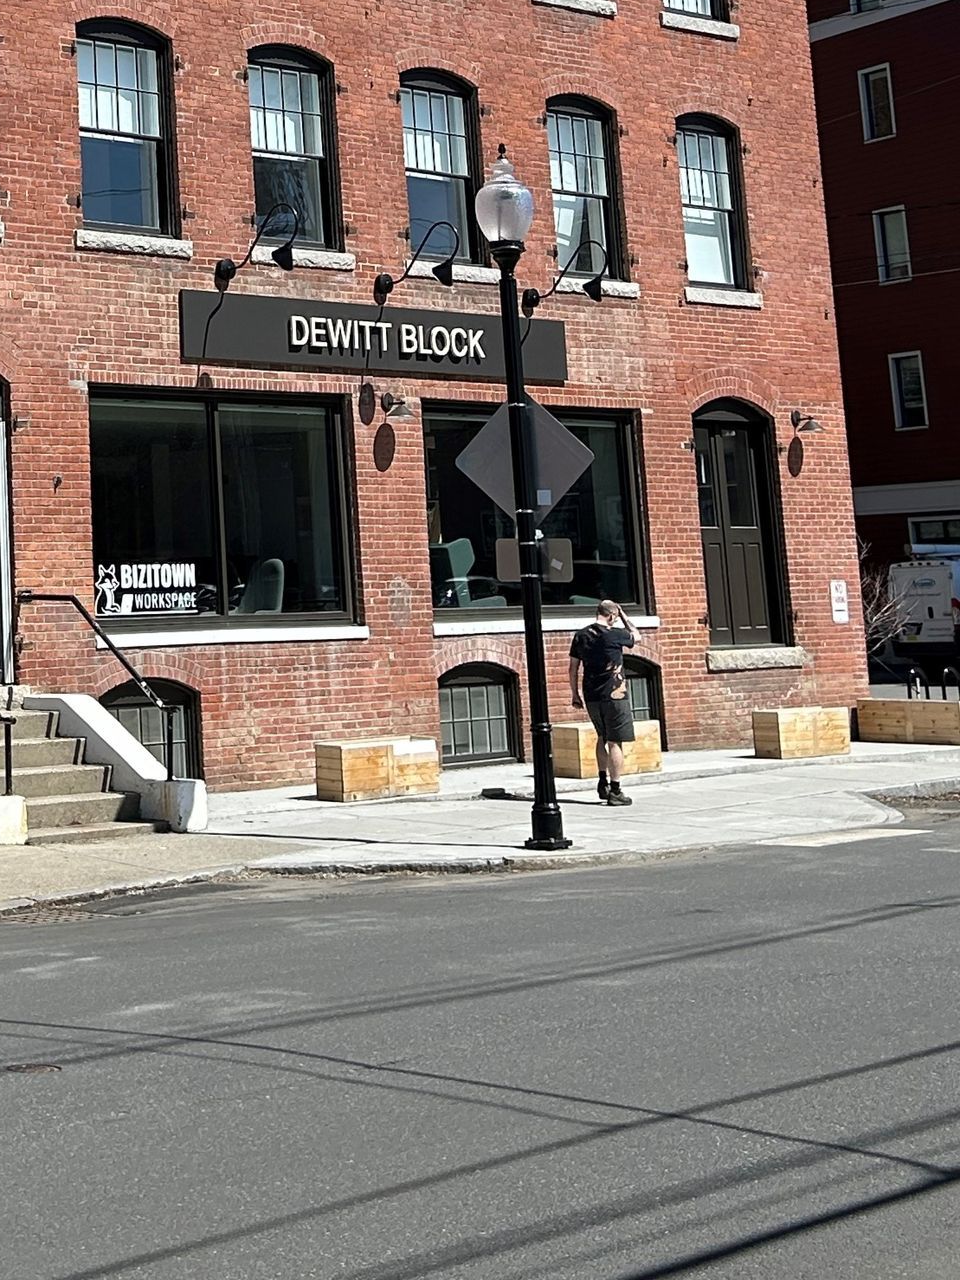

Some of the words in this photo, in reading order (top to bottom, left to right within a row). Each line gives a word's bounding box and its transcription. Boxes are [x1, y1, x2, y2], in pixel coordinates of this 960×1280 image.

[291, 315, 392, 351] DEWITT
[401, 323, 486, 358] BLOCK
[120, 563, 196, 589] BIZITOWN
[134, 592, 197, 609] WORKSPACE
